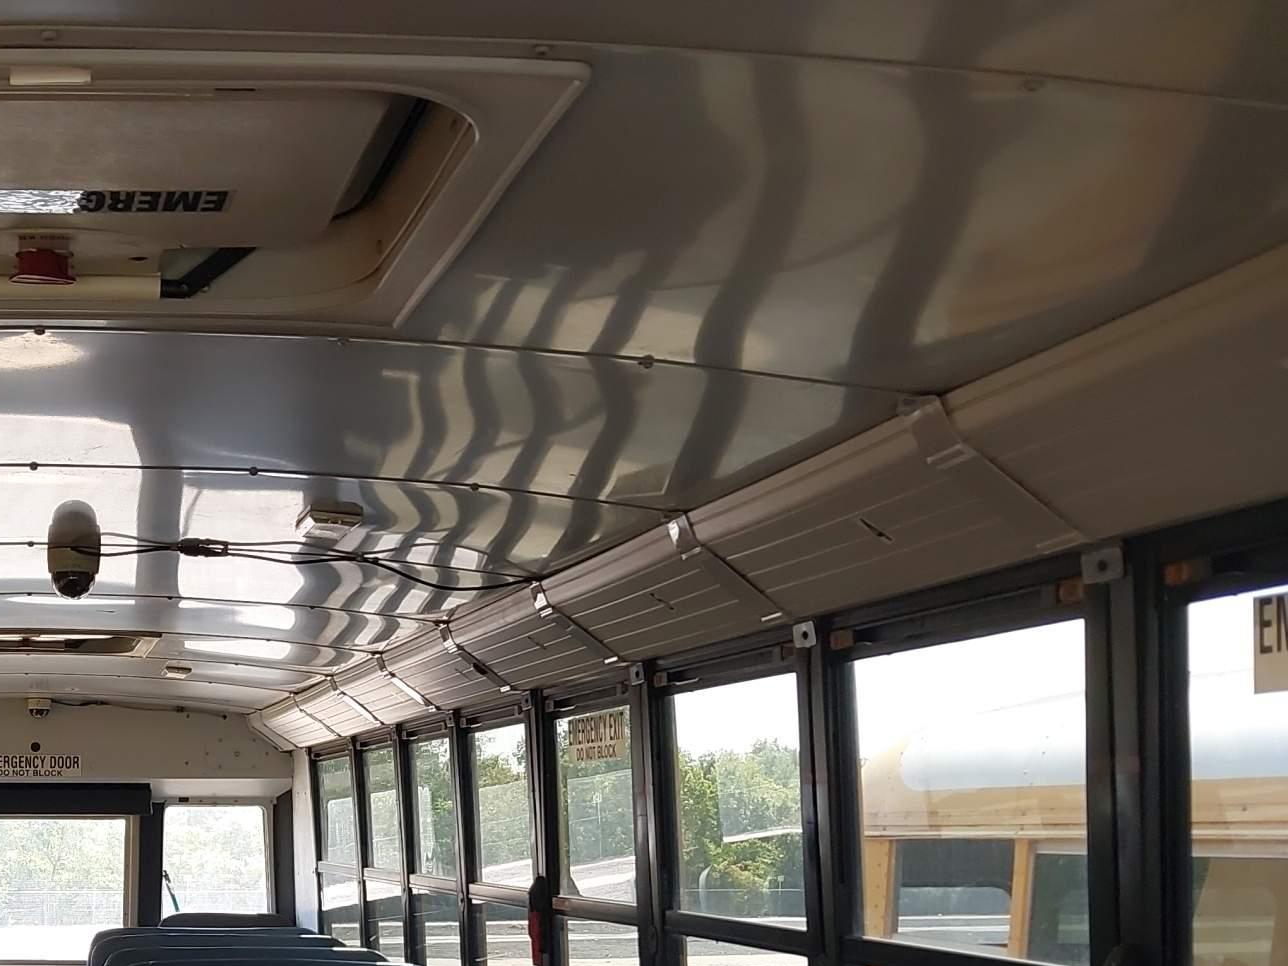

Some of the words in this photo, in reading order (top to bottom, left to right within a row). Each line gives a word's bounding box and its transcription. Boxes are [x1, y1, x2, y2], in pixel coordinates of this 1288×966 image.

[569, 714, 609, 746] EMERGENCY
[609, 711, 624, 740] EXIT
[597, 743, 617, 759] BLOCK
[49, 756, 80, 770] DOOR
[12, 769, 29, 777] NOT
[32, 769, 63, 777] BLOCK
